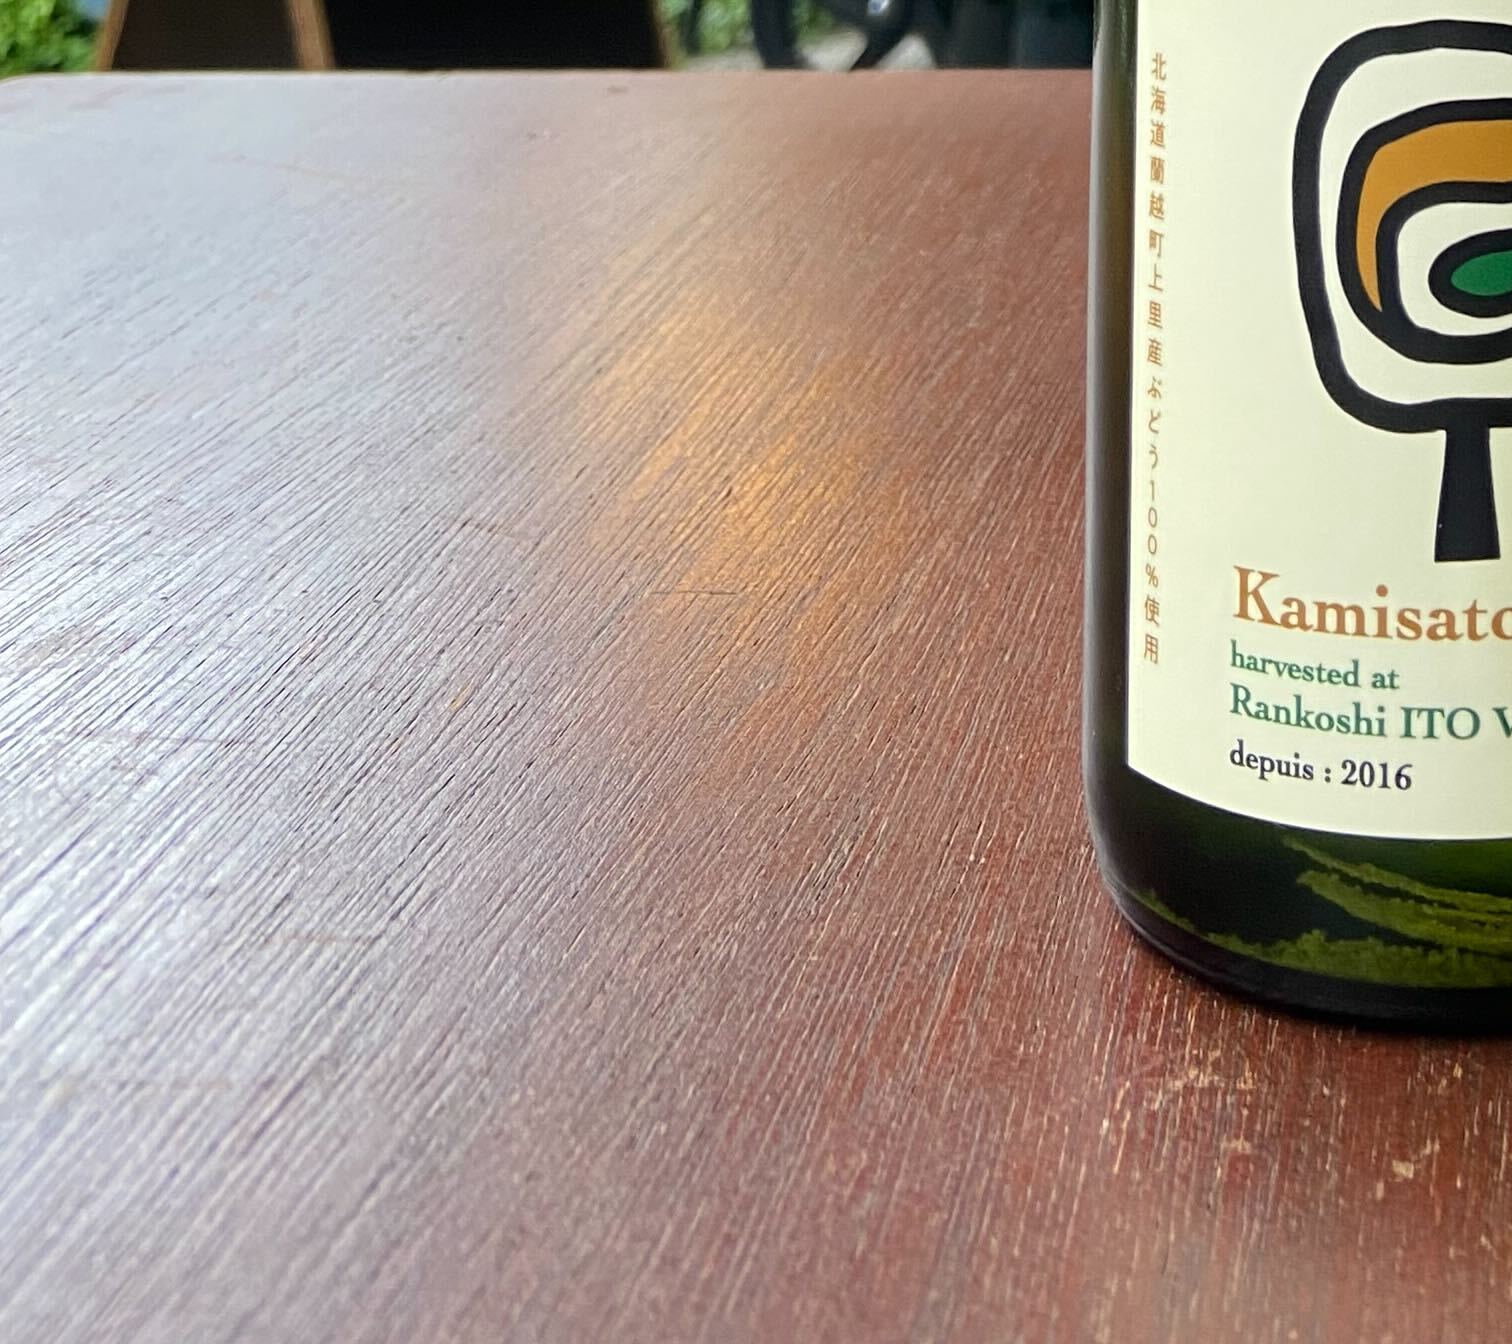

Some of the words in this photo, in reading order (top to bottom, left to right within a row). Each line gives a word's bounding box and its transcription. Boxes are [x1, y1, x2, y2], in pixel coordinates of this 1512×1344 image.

[1229, 638, 1361, 690] harvested
[1370, 668, 1400, 691] at
[1229, 681, 1388, 738] Rankoshi
[1399, 705, 1482, 741] ITO
[1228, 738, 1315, 782] depuis
[1340, 758, 1414, 792] 2016
